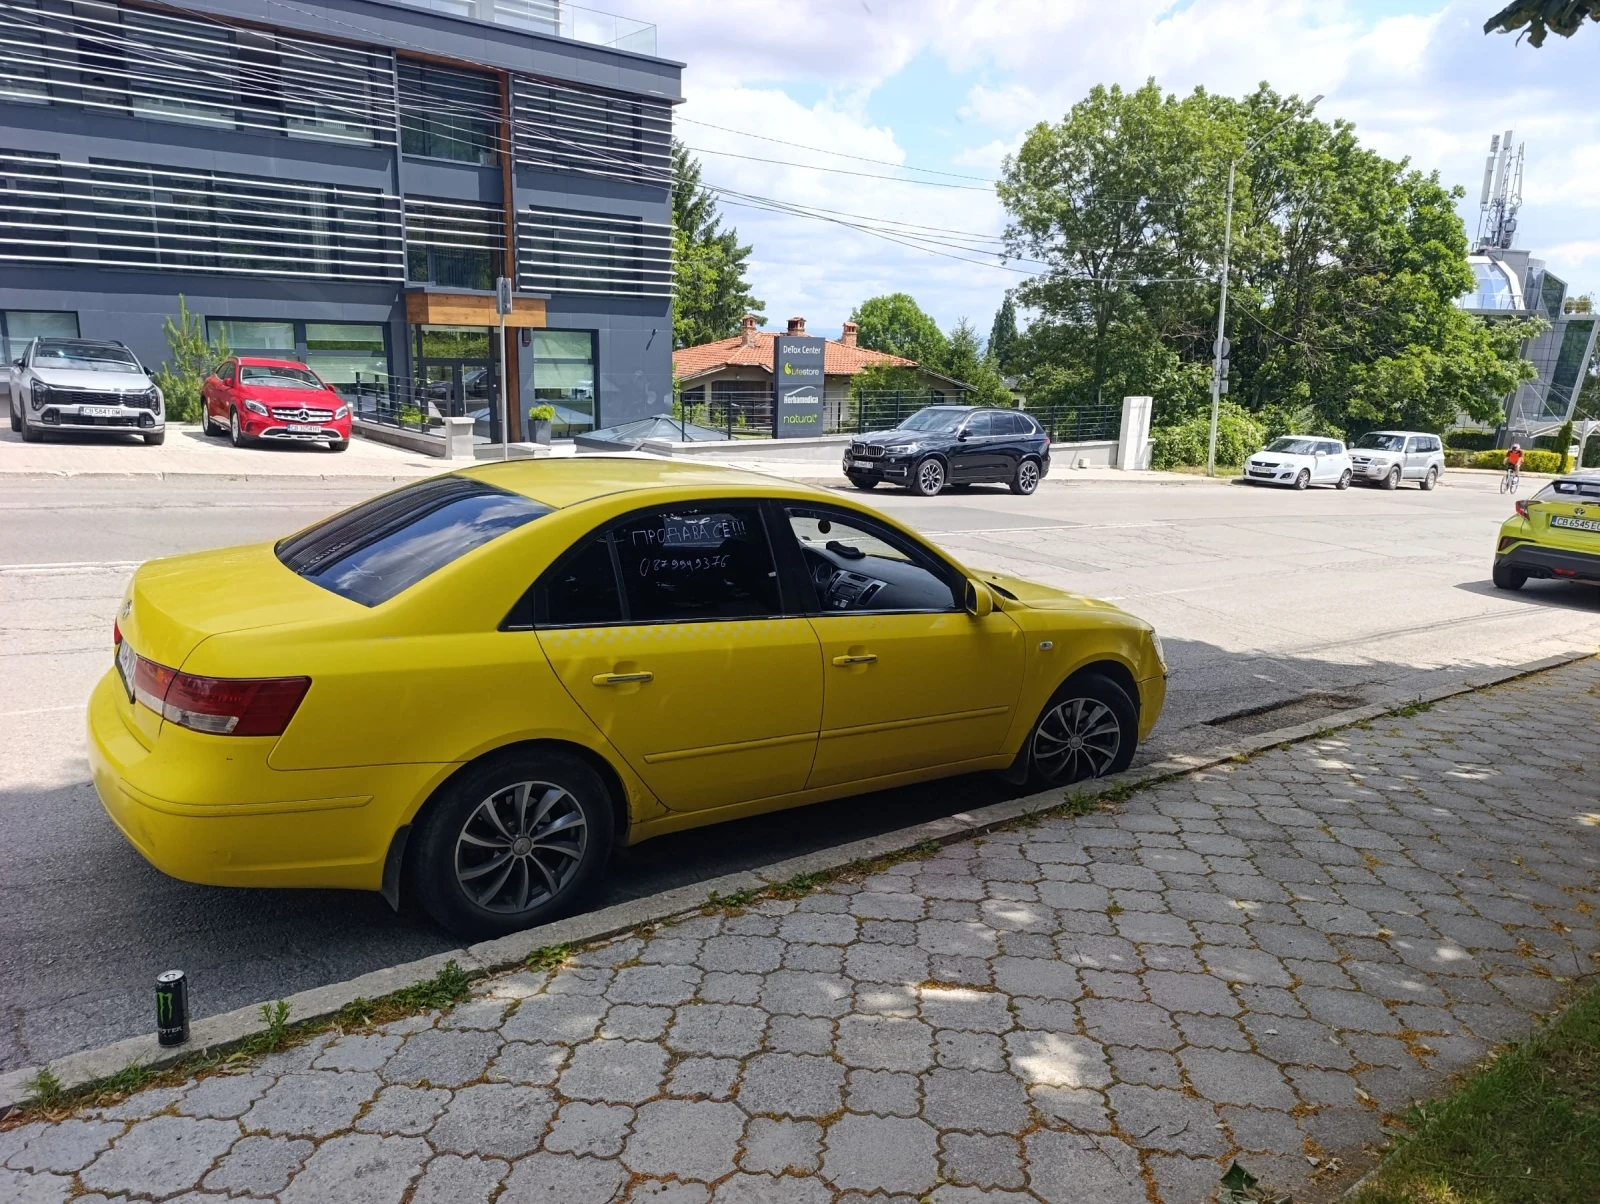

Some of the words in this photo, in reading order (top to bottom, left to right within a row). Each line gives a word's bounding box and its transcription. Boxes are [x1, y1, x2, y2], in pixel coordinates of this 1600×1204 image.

[783, 345, 801, 354] DeTox
[802, 345, 821, 355] Center
[791, 368, 819, 376] Lifestore
[783, 396, 819, 404] Herbamedica
[1557, 518, 1568, 526] CB
[1569, 519, 1590, 528] 6545
